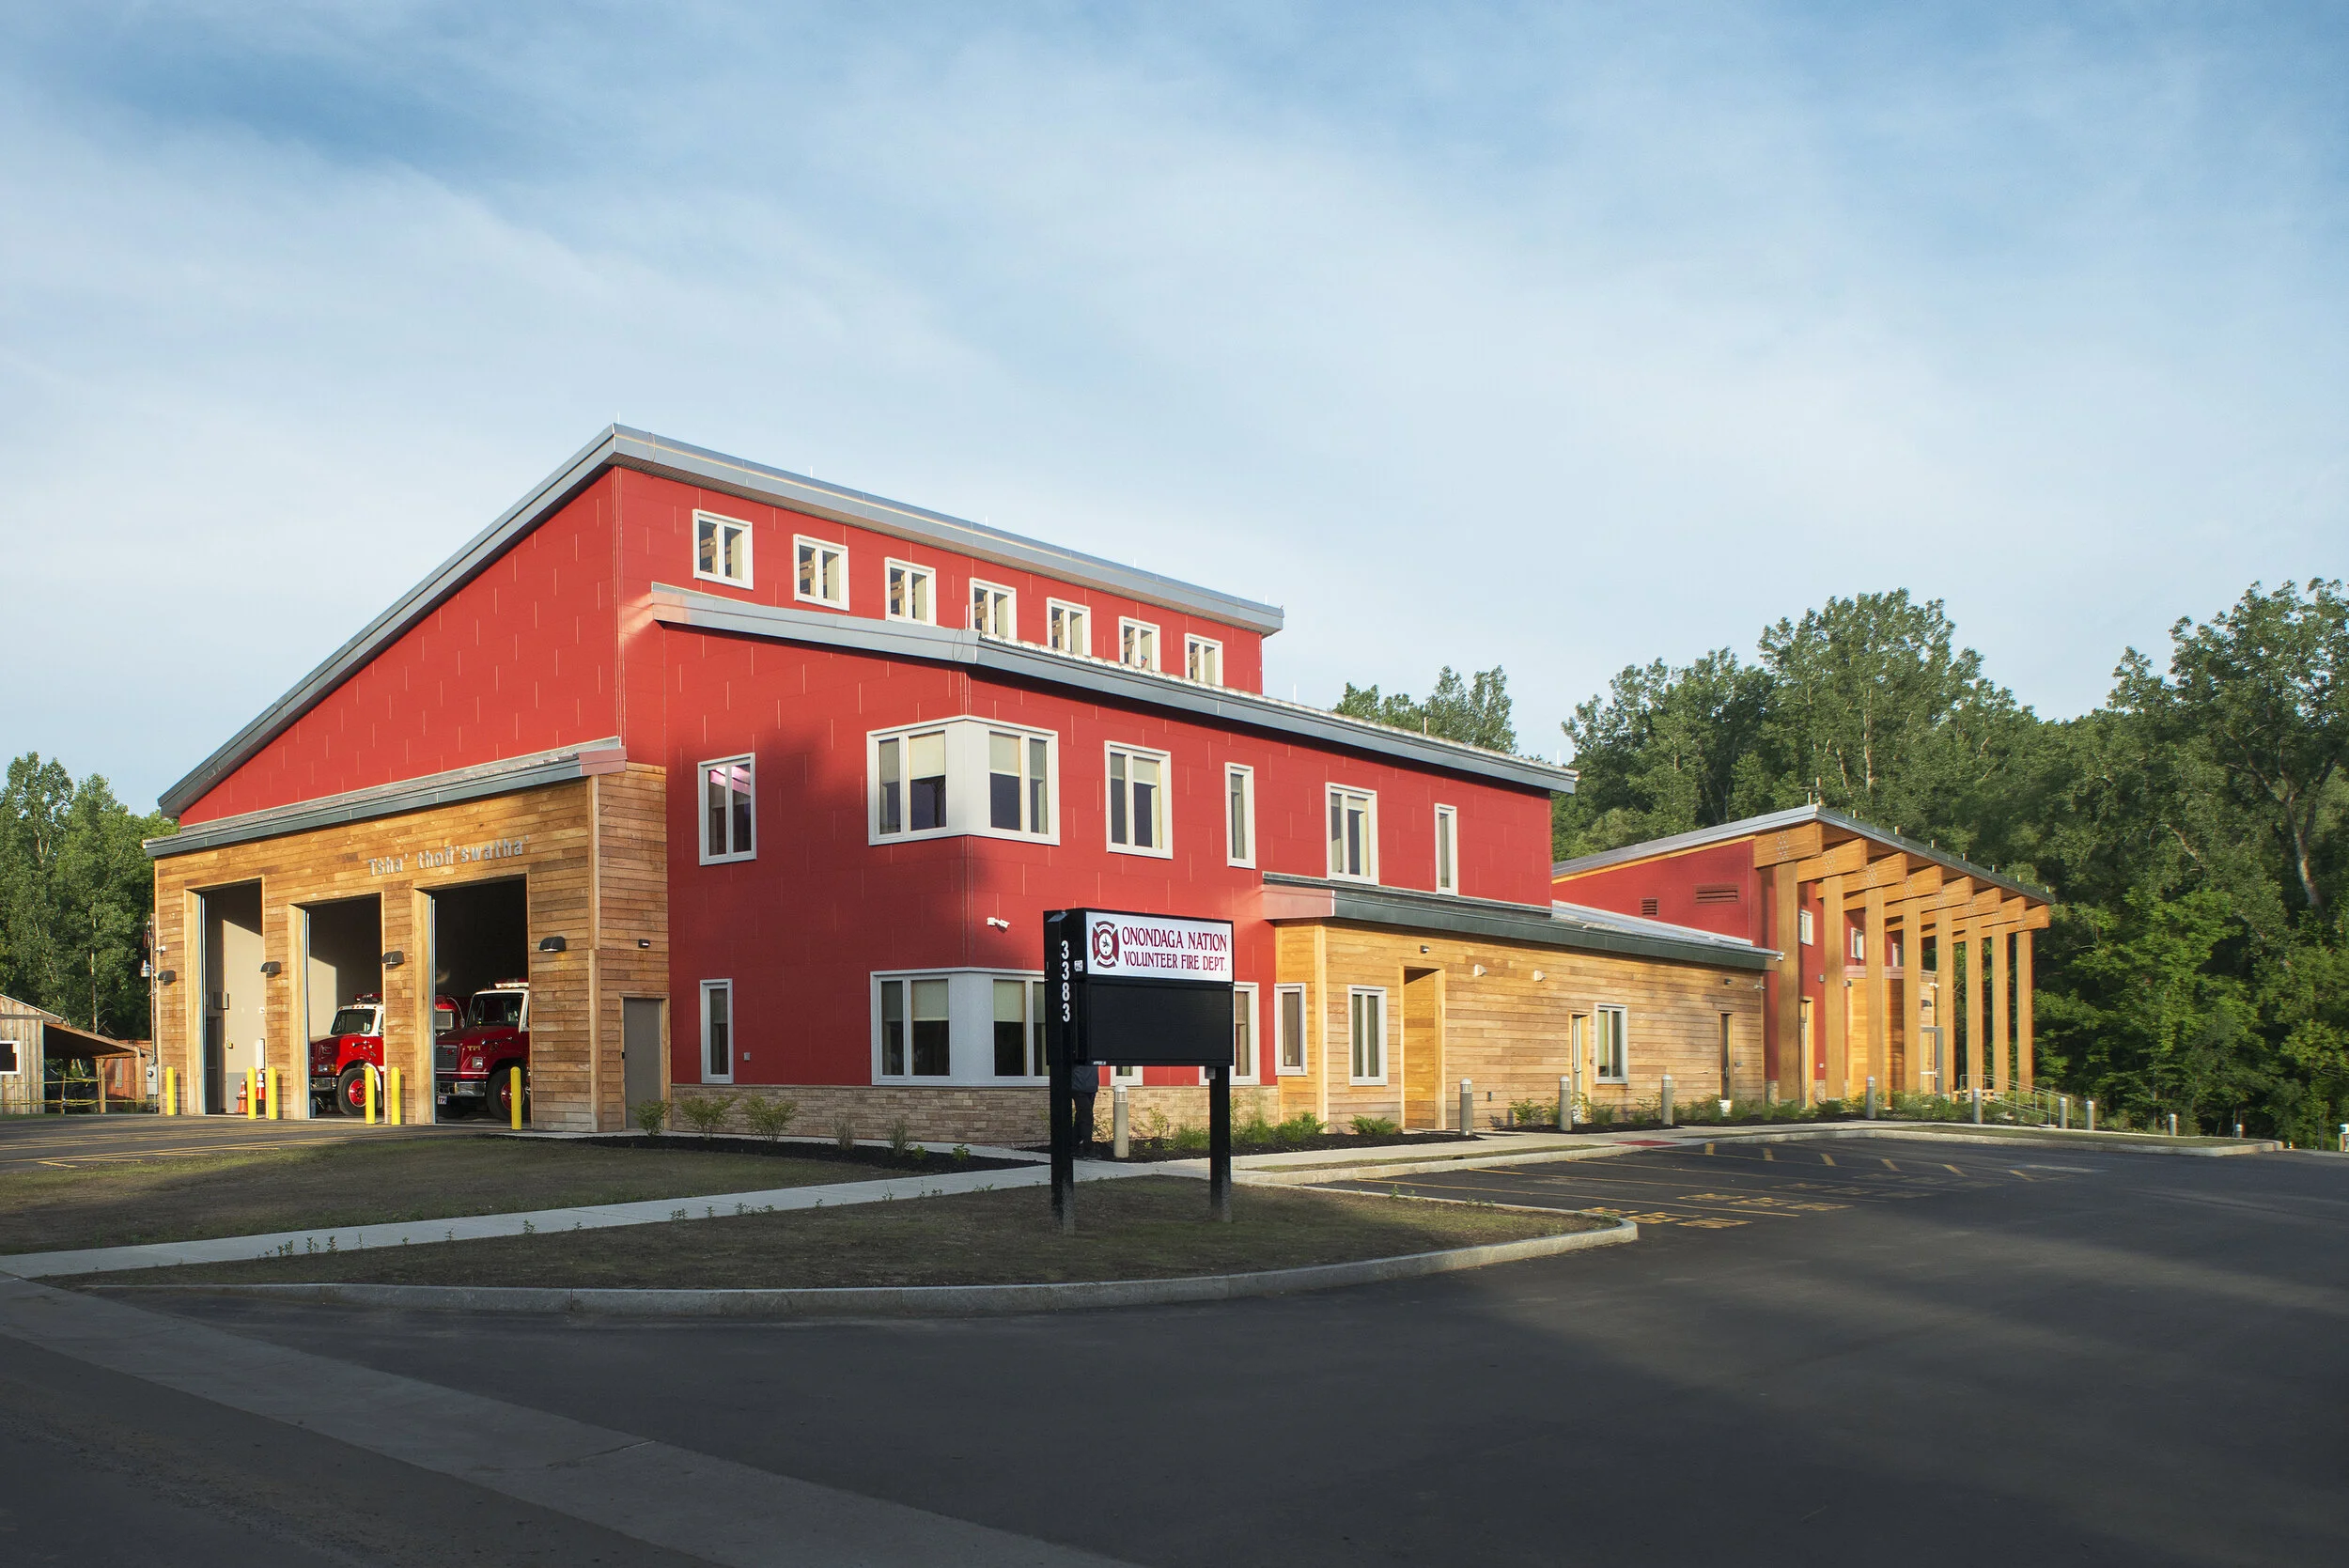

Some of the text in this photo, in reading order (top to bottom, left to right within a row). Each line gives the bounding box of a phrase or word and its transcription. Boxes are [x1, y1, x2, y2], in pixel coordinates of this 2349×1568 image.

[1122, 926, 1184, 949] ONONDAGA
[1188, 931, 1227, 952] NATION
[1124, 951, 1178, 969] VOLUNTEER
[1181, 955, 1200, 970] FIRE
[1203, 955, 1227, 971] DEPT.
[1061, 939, 1070, 1022] 3383
